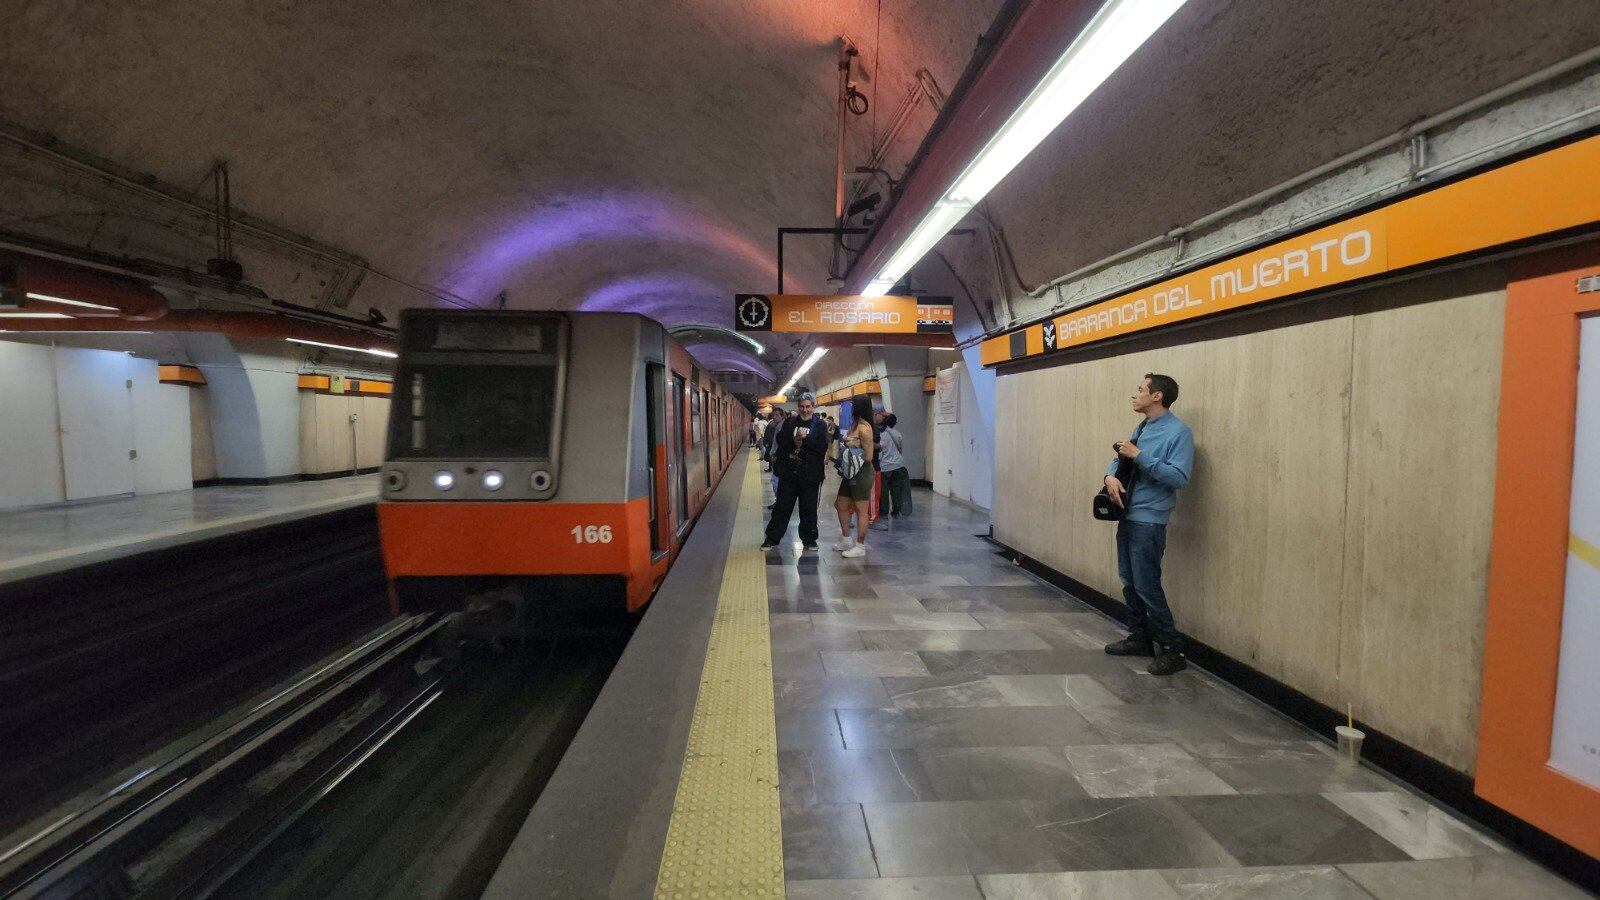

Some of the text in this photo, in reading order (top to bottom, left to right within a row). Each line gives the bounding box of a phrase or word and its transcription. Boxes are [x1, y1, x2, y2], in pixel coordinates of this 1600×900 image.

[1059, 229, 1371, 341] BARRANCA DEL MUERTO
[788, 311, 901, 324] EL ROSARIO
[571, 525, 613, 544] 166
